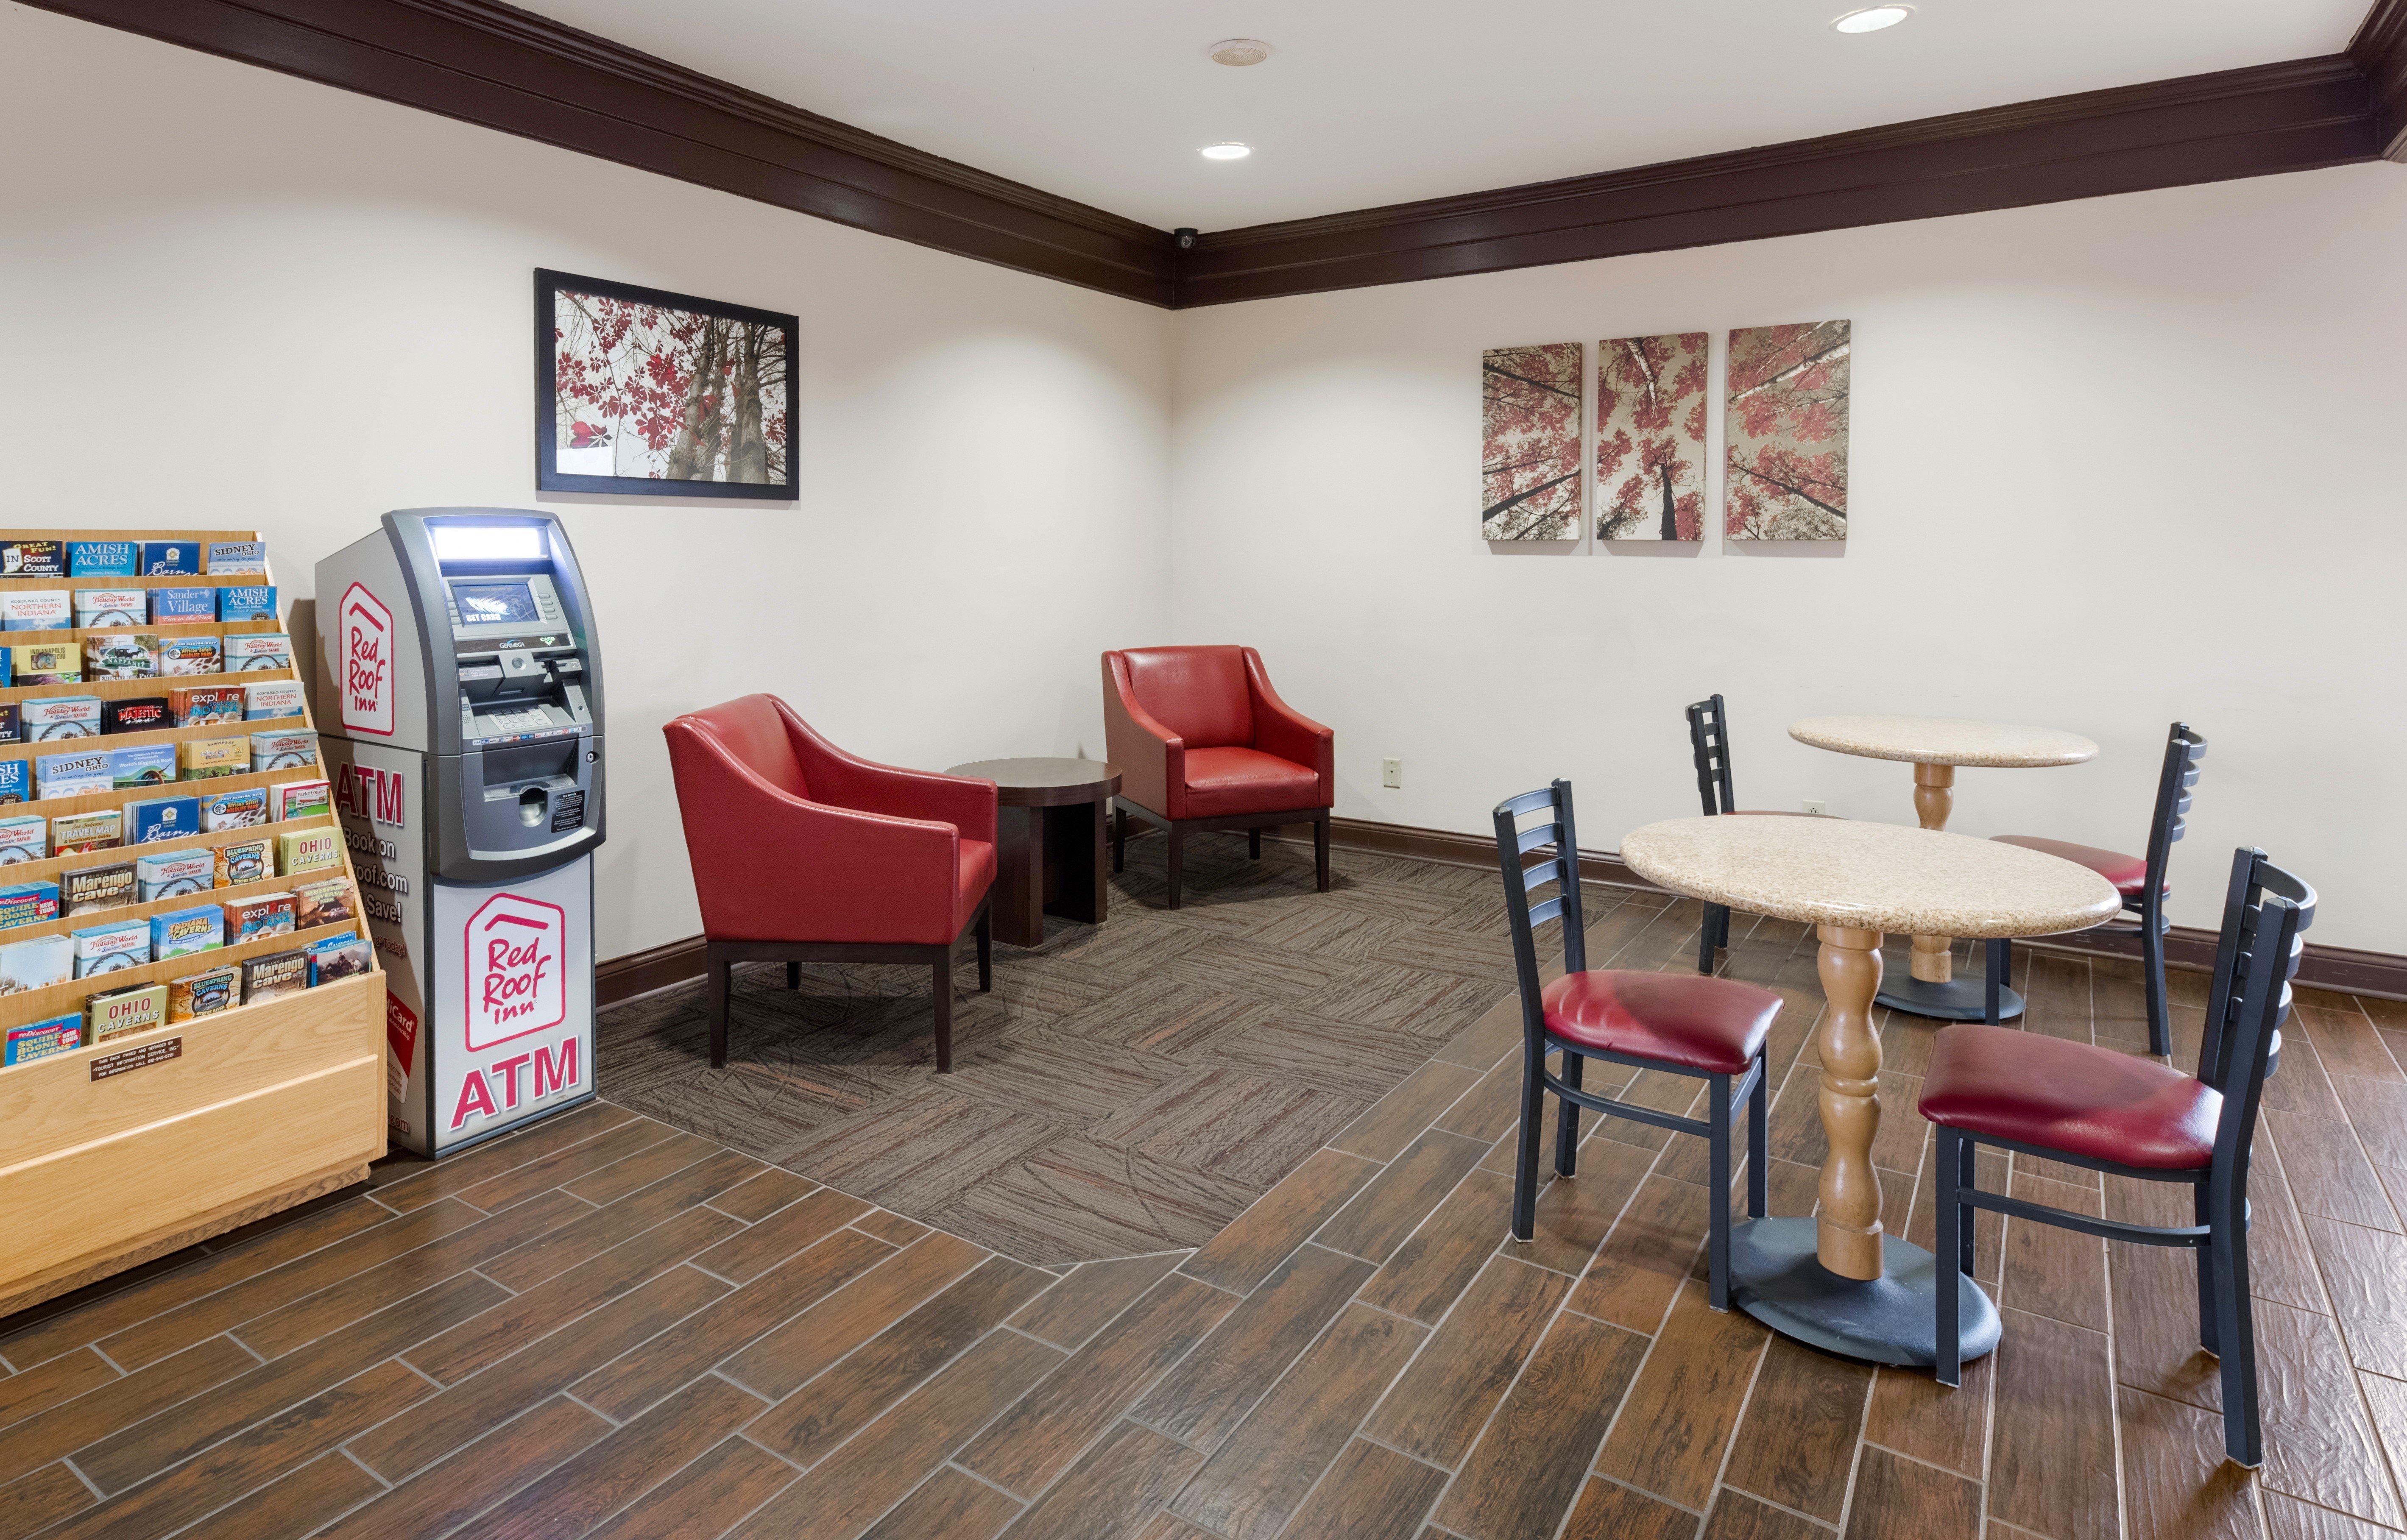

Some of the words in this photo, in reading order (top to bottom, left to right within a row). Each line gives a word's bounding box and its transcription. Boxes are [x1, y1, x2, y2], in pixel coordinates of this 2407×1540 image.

[31, 545, 56, 553] FUN!
[75, 544, 129, 554] AMISH
[215, 544, 255, 556] SIDNEY
[75, 555, 128, 565] ACRES
[147, 561, 186, 576] Barn
[167, 589, 198, 599] Sauder
[228, 588, 268, 597] AMISH
[92, 596, 117, 604] Holiday
[168, 600, 208, 613] Village
[229, 597, 268, 606] ACRES
[481, 613, 502, 621] CASH
[245, 642, 266, 651] Holiday
[351, 627, 378, 661] Red
[108, 659, 145, 668] NAPPANEE
[349, 658, 386, 700] Roof
[257, 693, 296, 702] NORTHERN
[44, 708, 70, 717] Holiday
[118, 709, 161, 721] MAJESTIC
[190, 704, 238, 716] INDIANA
[271, 741, 293, 749] Holiday
[52, 756, 103, 774] SIDNEY
[85, 763, 108, 771] OHIO
[337, 761, 404, 827] ATM
[11, 829, 34, 837] World
[61, 828, 94, 839] TRAVEL
[95, 824, 116, 834] MAP
[141, 824, 184, 841] Barn
[69, 835, 97, 843] Destination
[299, 837, 332, 854] OHIO
[343, 827, 376, 854] Book
[379, 839, 395, 859] on
[226, 845, 263, 856] BLUESPRING
[230, 853, 260, 863] CAVERNS
[292, 849, 339, 866] CAVERNS
[161, 867, 185, 876] Holiday
[73, 872, 132, 893] Marengo
[73, 886, 119, 902] cave
[310, 891, 344, 902] CAVERNS
[39, 901, 53, 909] NEW
[39, 905, 55, 914] TOUR
[366, 893, 402, 923] Save!
[168, 917, 208, 937] INDIANA
[242, 915, 290, 933] INDIANA
[172, 925, 212, 940] CAVERNS
[90, 940, 117, 950] Holiday
[117, 934, 138, 942] World
[383, 937, 406, 956] Today!
[488, 936, 541, 977] Red
[253, 958, 304, 980] Marengo
[193, 975, 232, 990] BLUESPRING
[253, 972, 292, 989] cave
[483, 955, 552, 1013] Roof
[196, 983, 228, 997] CAVERNS
[109, 997, 151, 1019] OHIO
[98, 1010, 160, 1033] CAVERNS
[18, 1026, 60, 1038] reDiscover
[62, 1030, 76, 1039] NEW
[389, 1017, 410, 1041] membership
[17, 1032, 61, 1048] SQUIRE
[62, 1035, 78, 1044] TOUR
[17, 1040, 58, 1055] BOONE
[17, 1044, 71, 1062] CAVERNS
[148, 1043, 166, 1051] SERVICED
[117, 1055, 145, 1066] INFORMATION
[109, 1064, 134, 1075] INFORMATION
[448, 1034, 579, 1131] ATM
